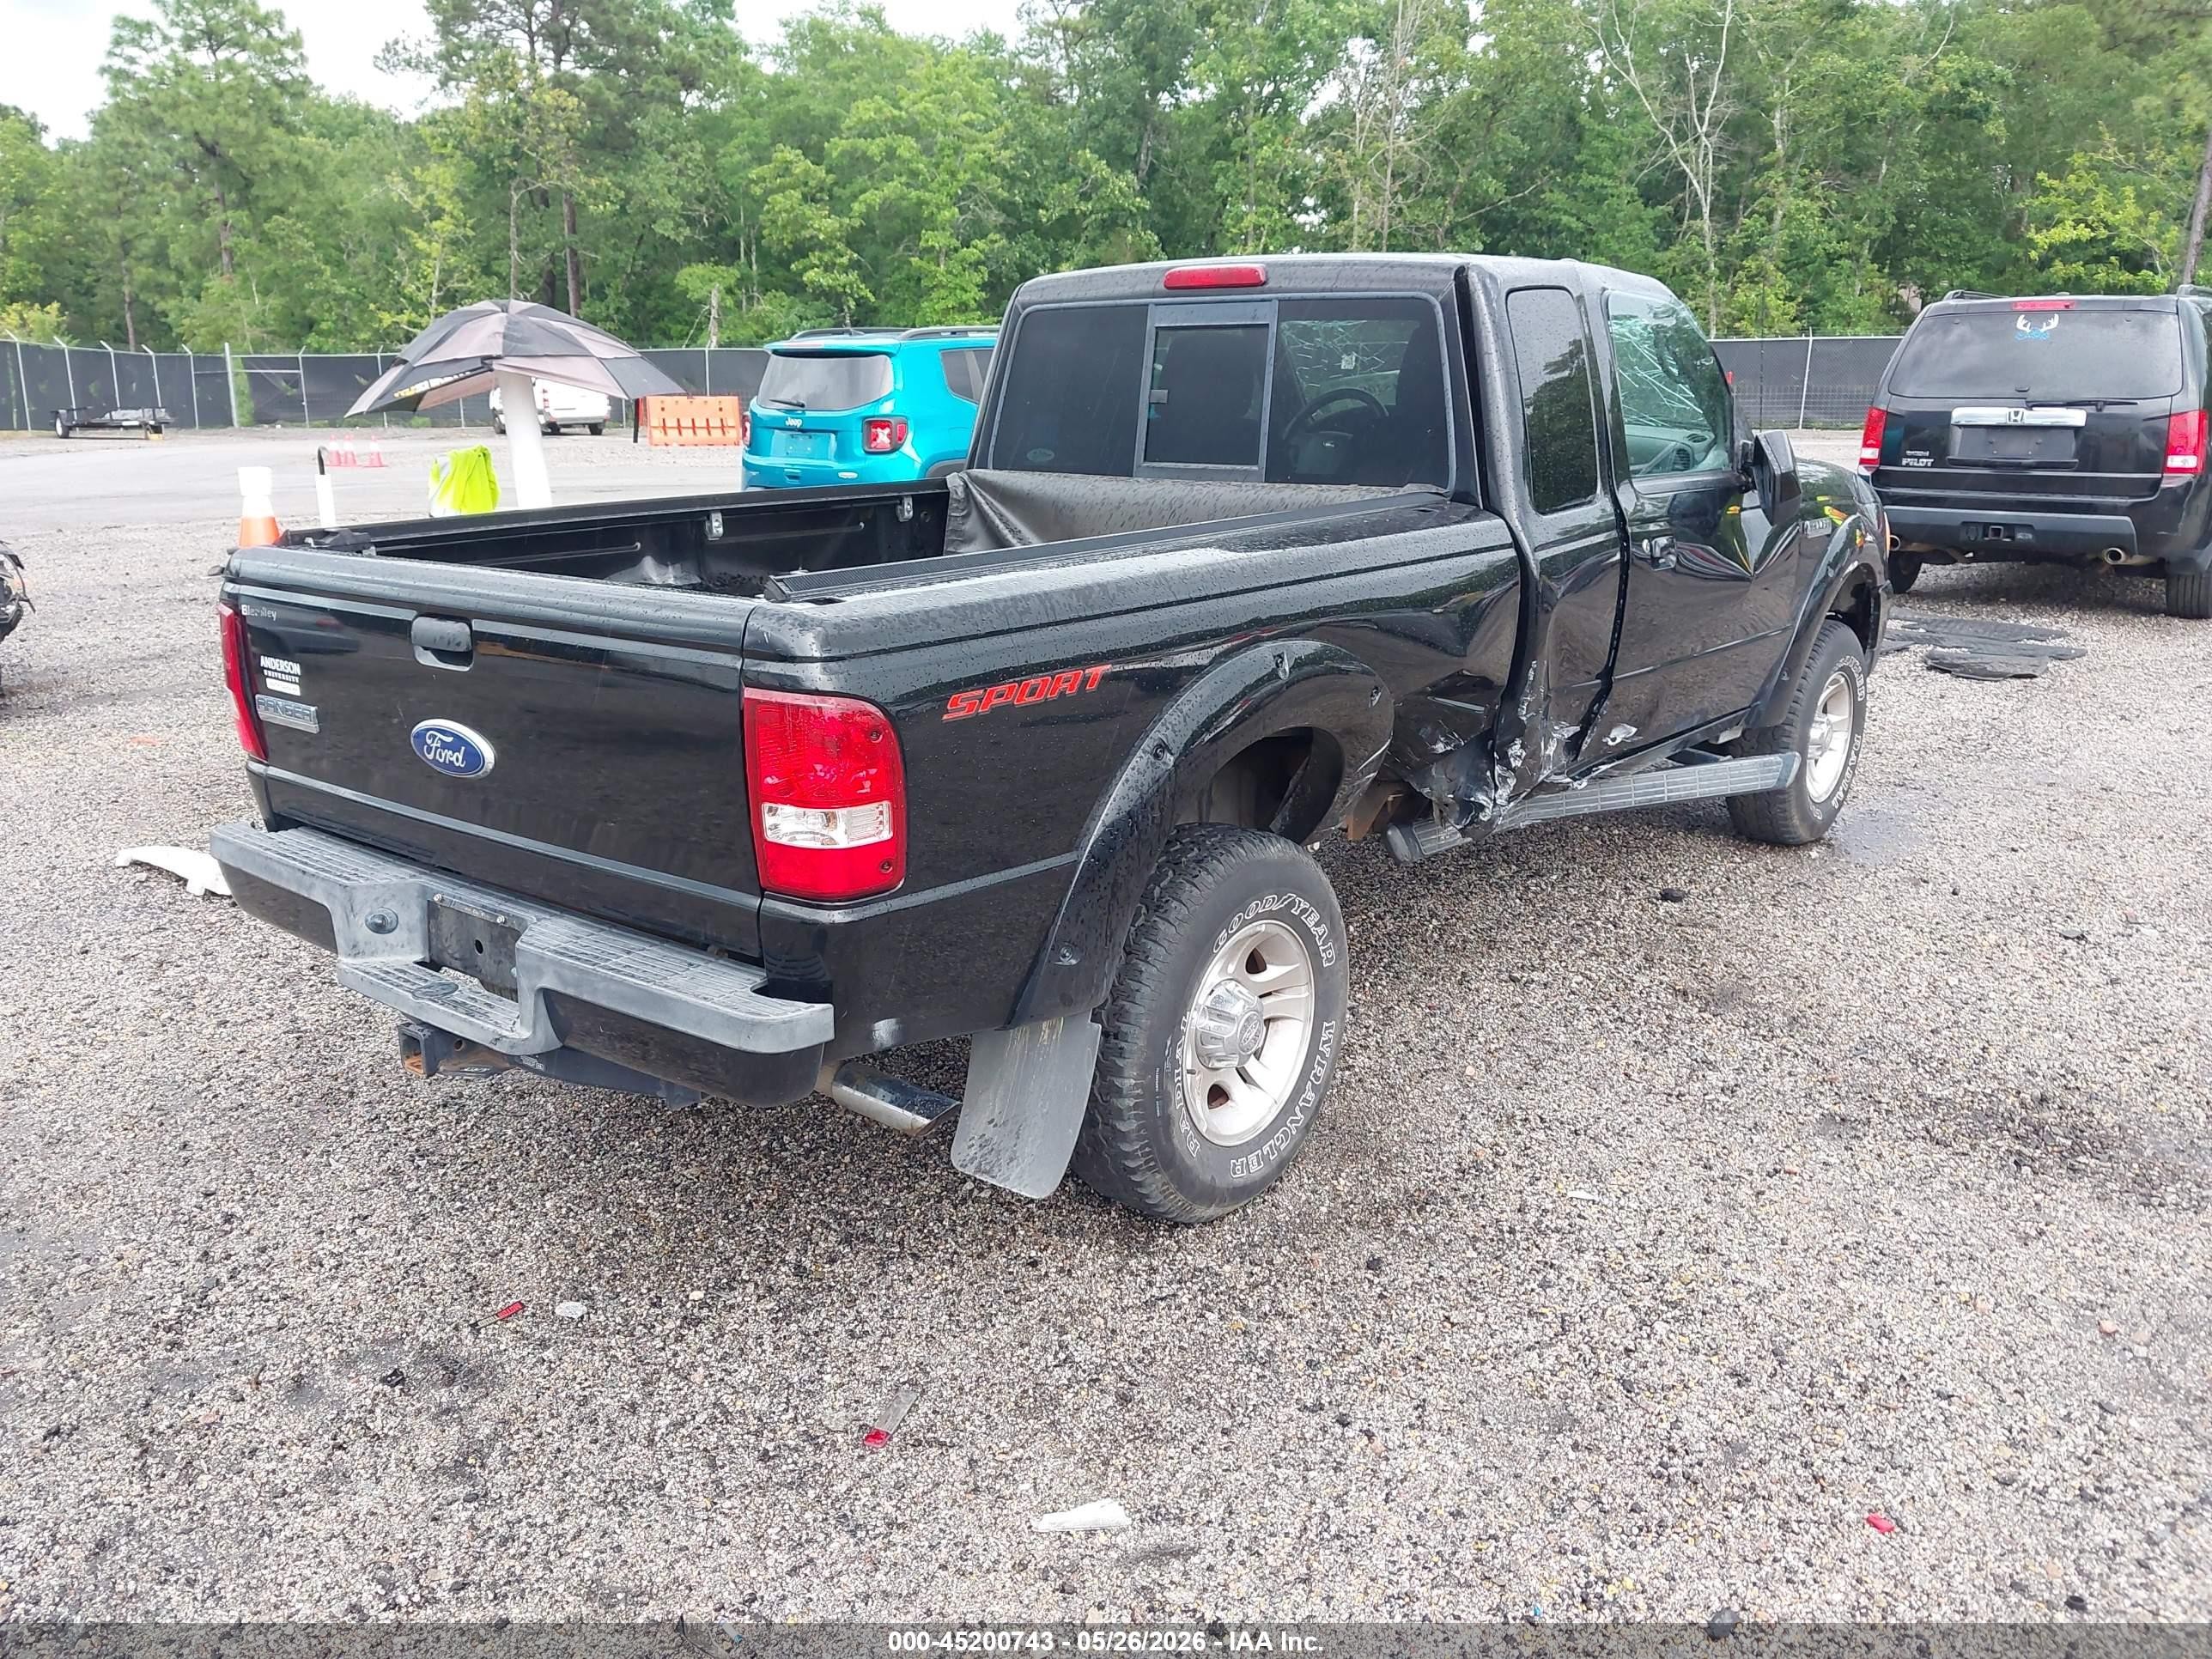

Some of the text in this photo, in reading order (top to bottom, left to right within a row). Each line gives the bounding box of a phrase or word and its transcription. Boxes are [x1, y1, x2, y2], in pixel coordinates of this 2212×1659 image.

[785, 417, 803, 428] Jeep
[1901, 458, 1935, 467] PILOT
[260, 655, 301, 676] ANDERSON
[263, 669, 300, 683] UNIVERSITY
[941, 665, 1113, 722] SPORT
[258, 697, 315, 724] RANGER
[423, 730, 466, 768] Ford
[1230, 1020, 1336, 1178] WRANGLER
